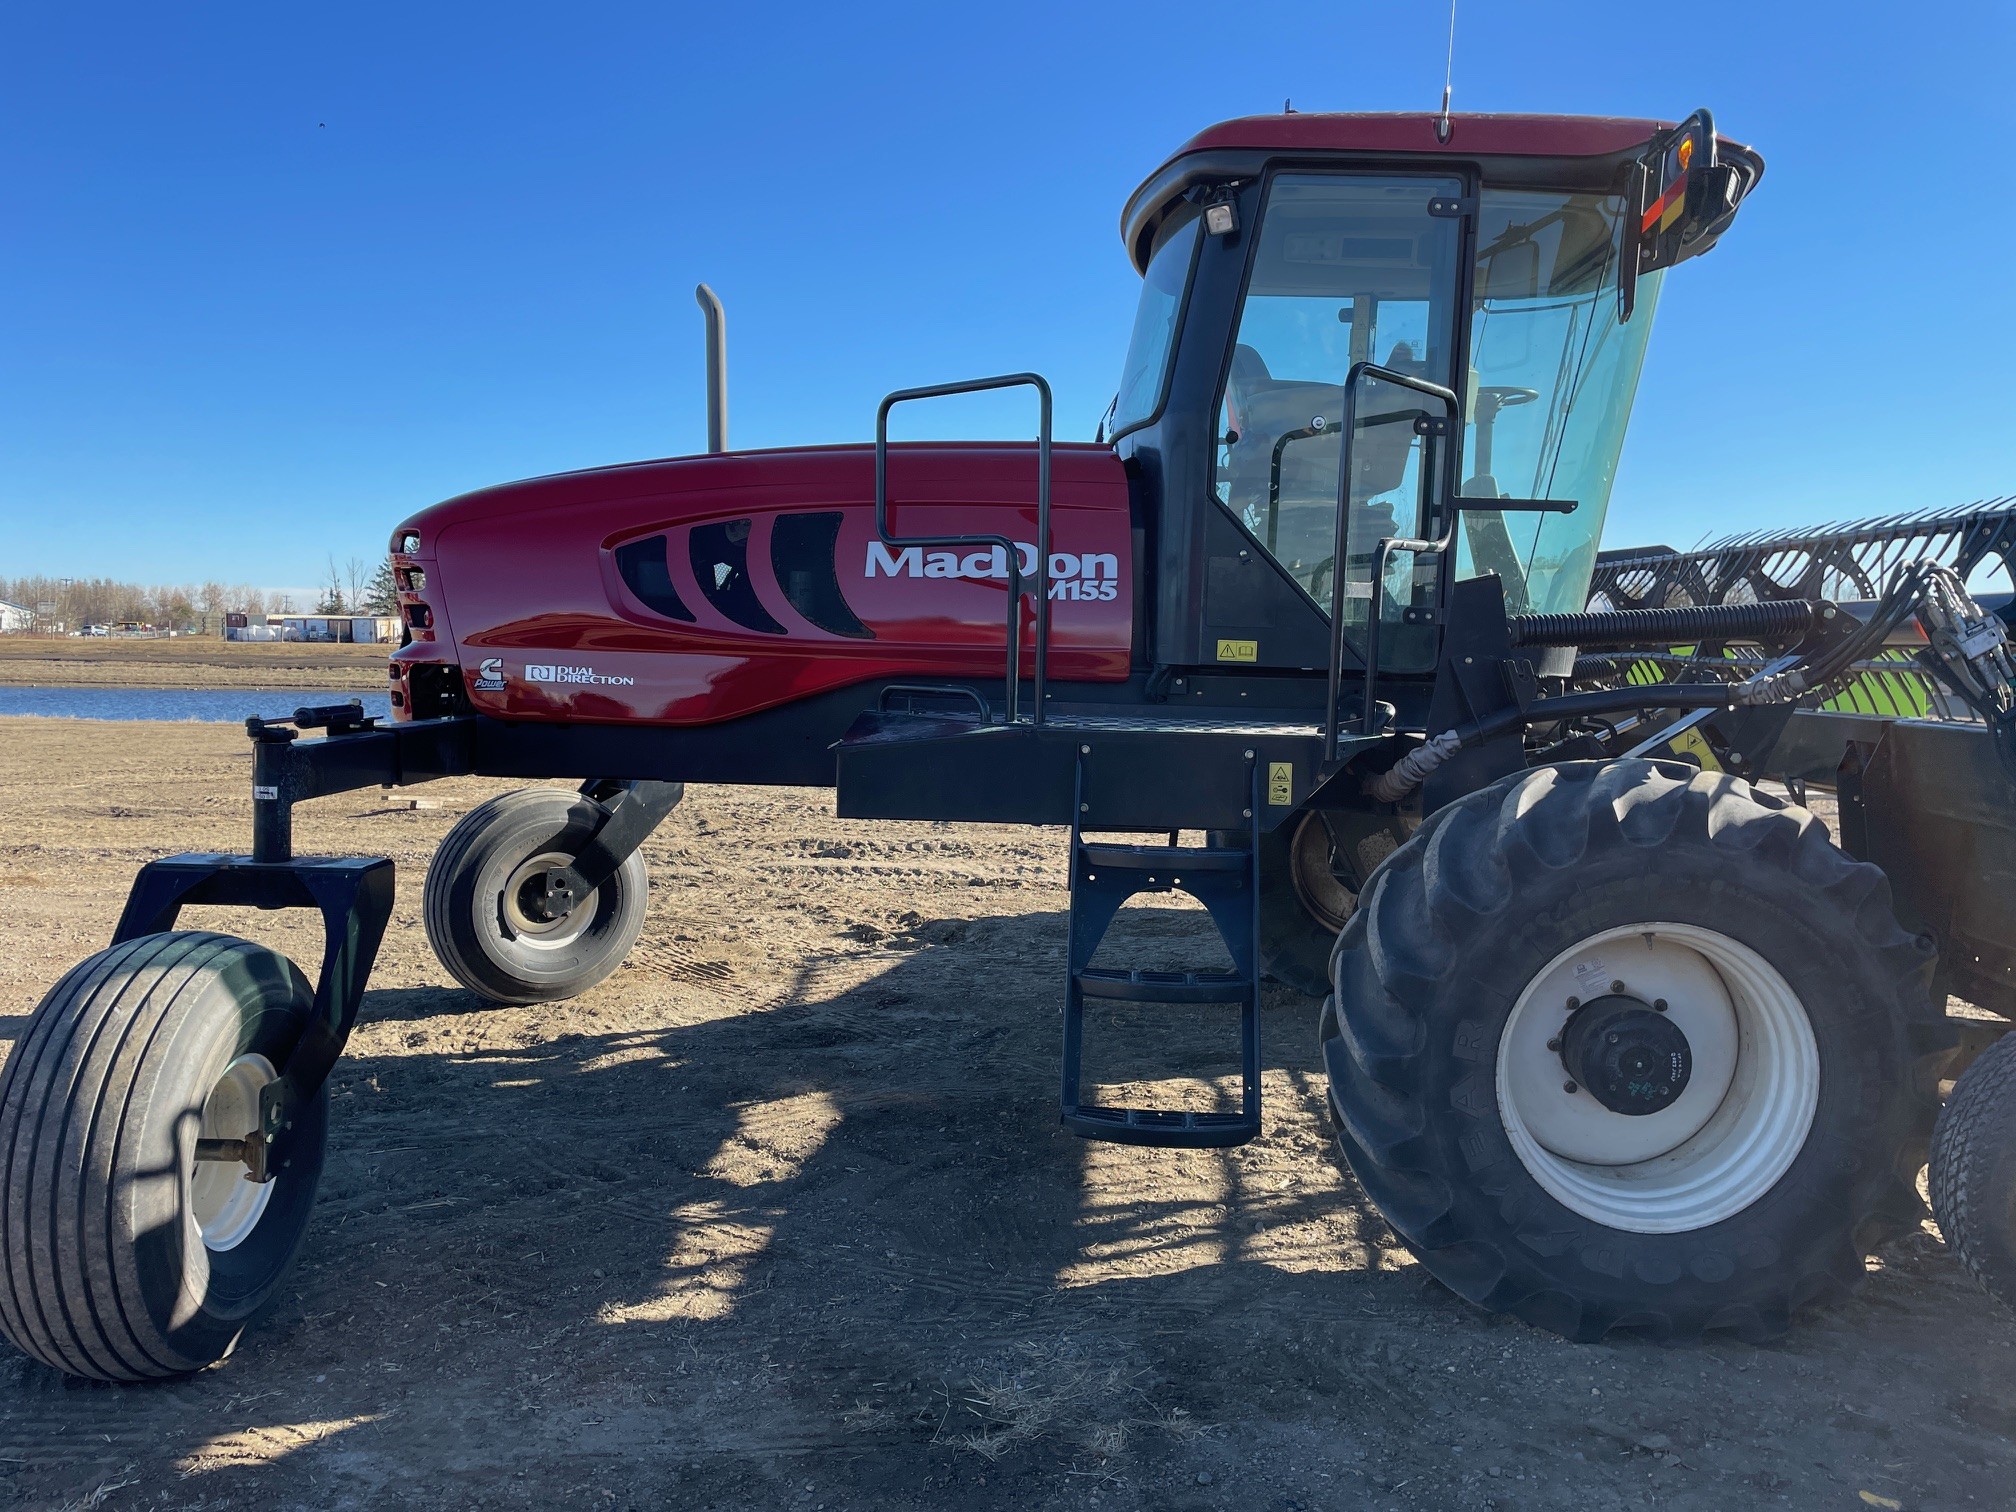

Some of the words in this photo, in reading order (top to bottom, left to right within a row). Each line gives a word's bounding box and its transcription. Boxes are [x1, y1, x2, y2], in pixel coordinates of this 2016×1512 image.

[864, 541, 1119, 579] MacDon
[557, 666, 597, 676] DUAL
[556, 674, 634, 686] DIRECTION
